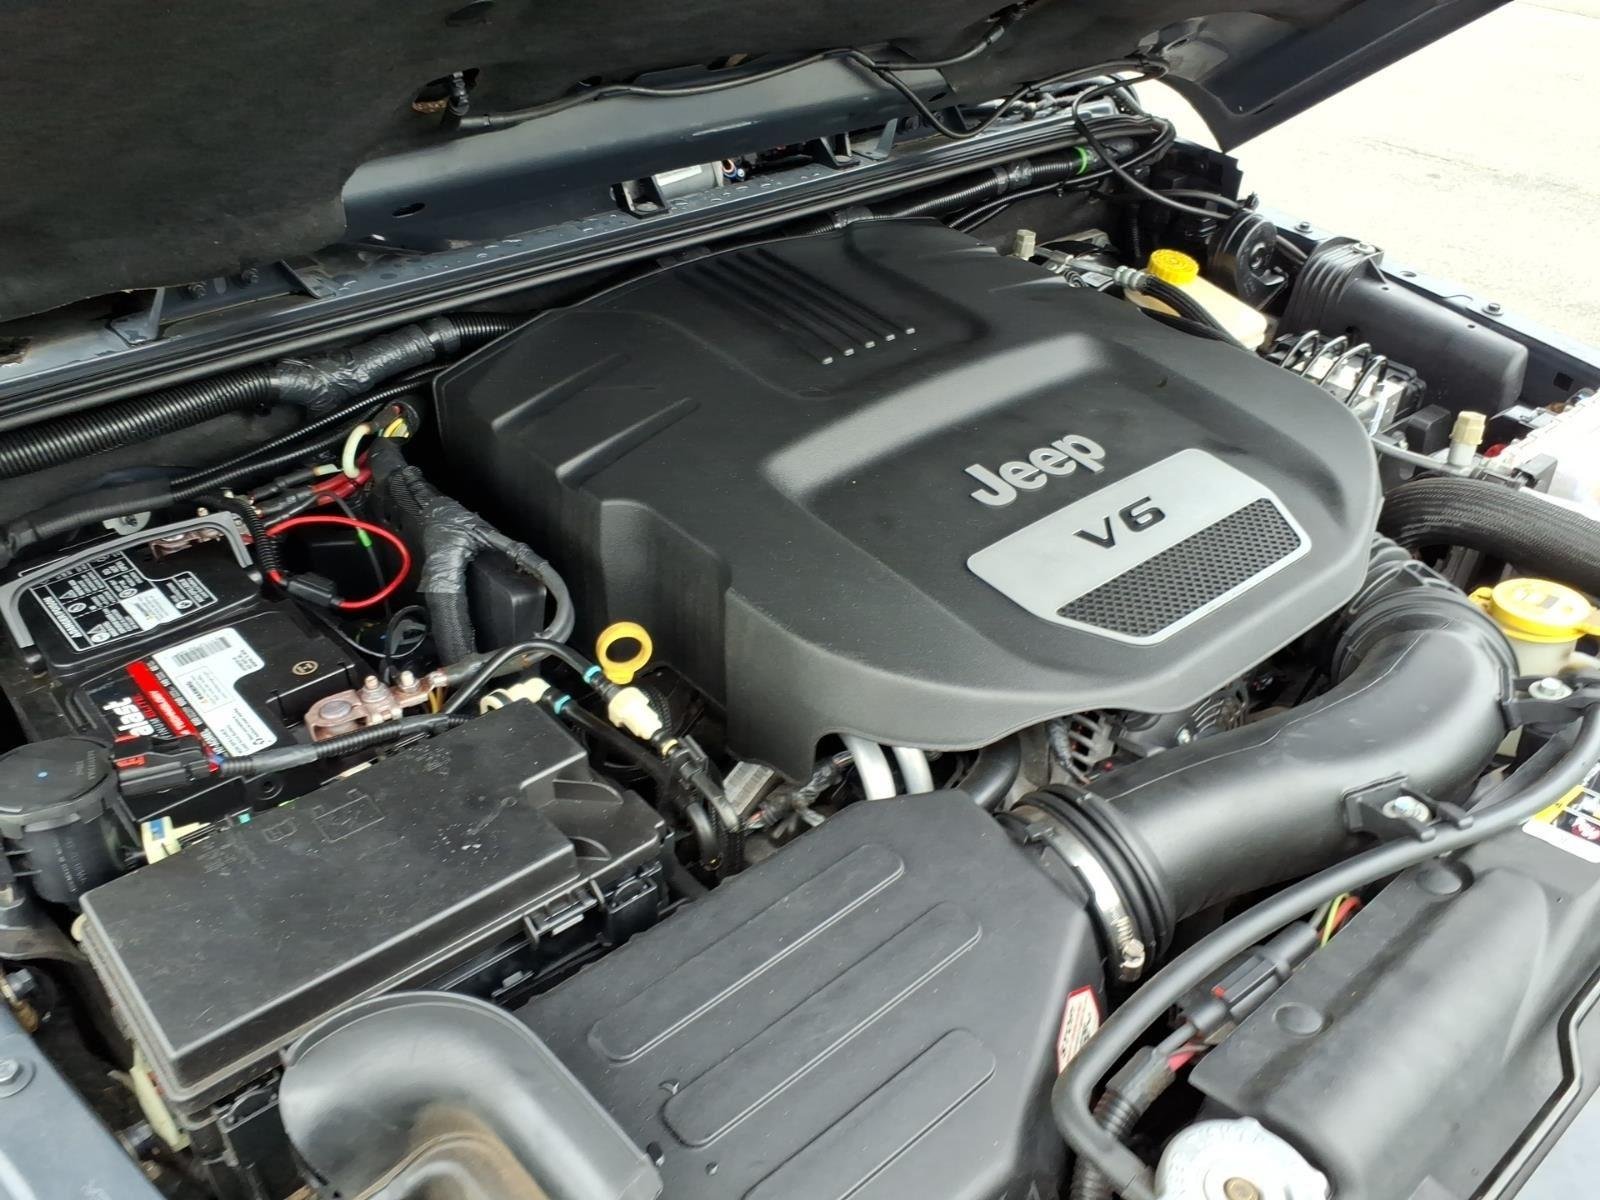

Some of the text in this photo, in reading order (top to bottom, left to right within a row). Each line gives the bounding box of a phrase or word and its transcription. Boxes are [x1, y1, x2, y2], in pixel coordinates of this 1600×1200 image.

[964, 433, 1106, 507] Jeep
[1072, 496, 1167, 550] V6
[103, 697, 154, 738] alast
[147, 690, 185, 730] TECHNOLOGY
